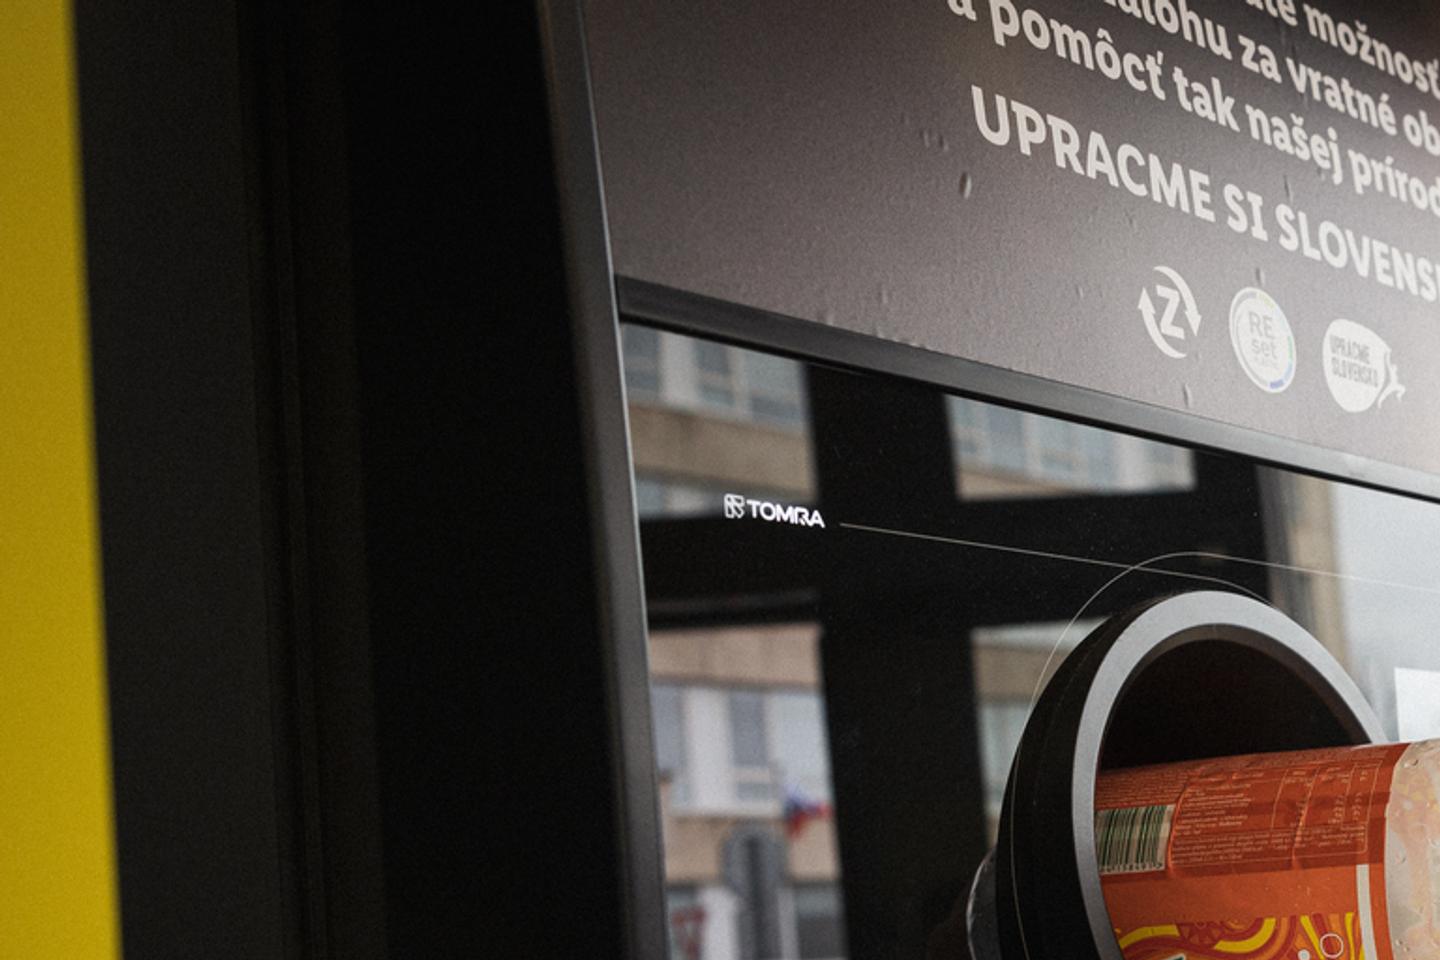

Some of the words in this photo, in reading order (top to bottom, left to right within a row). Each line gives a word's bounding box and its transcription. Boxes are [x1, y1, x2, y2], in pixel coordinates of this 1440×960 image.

[989, 0, 1165, 100] pomôcť
[1172, 66, 1240, 132] tak
[1245, 103, 1343, 185] našej
[1238, 34, 1282, 84] za
[1286, 57, 1397, 136] vratné
[971, 85, 1216, 222] UPRACME
[1223, 183, 1269, 241] SI
[1248, 311, 1275, 339] RE
[746, 499, 826, 528] TOMRA
